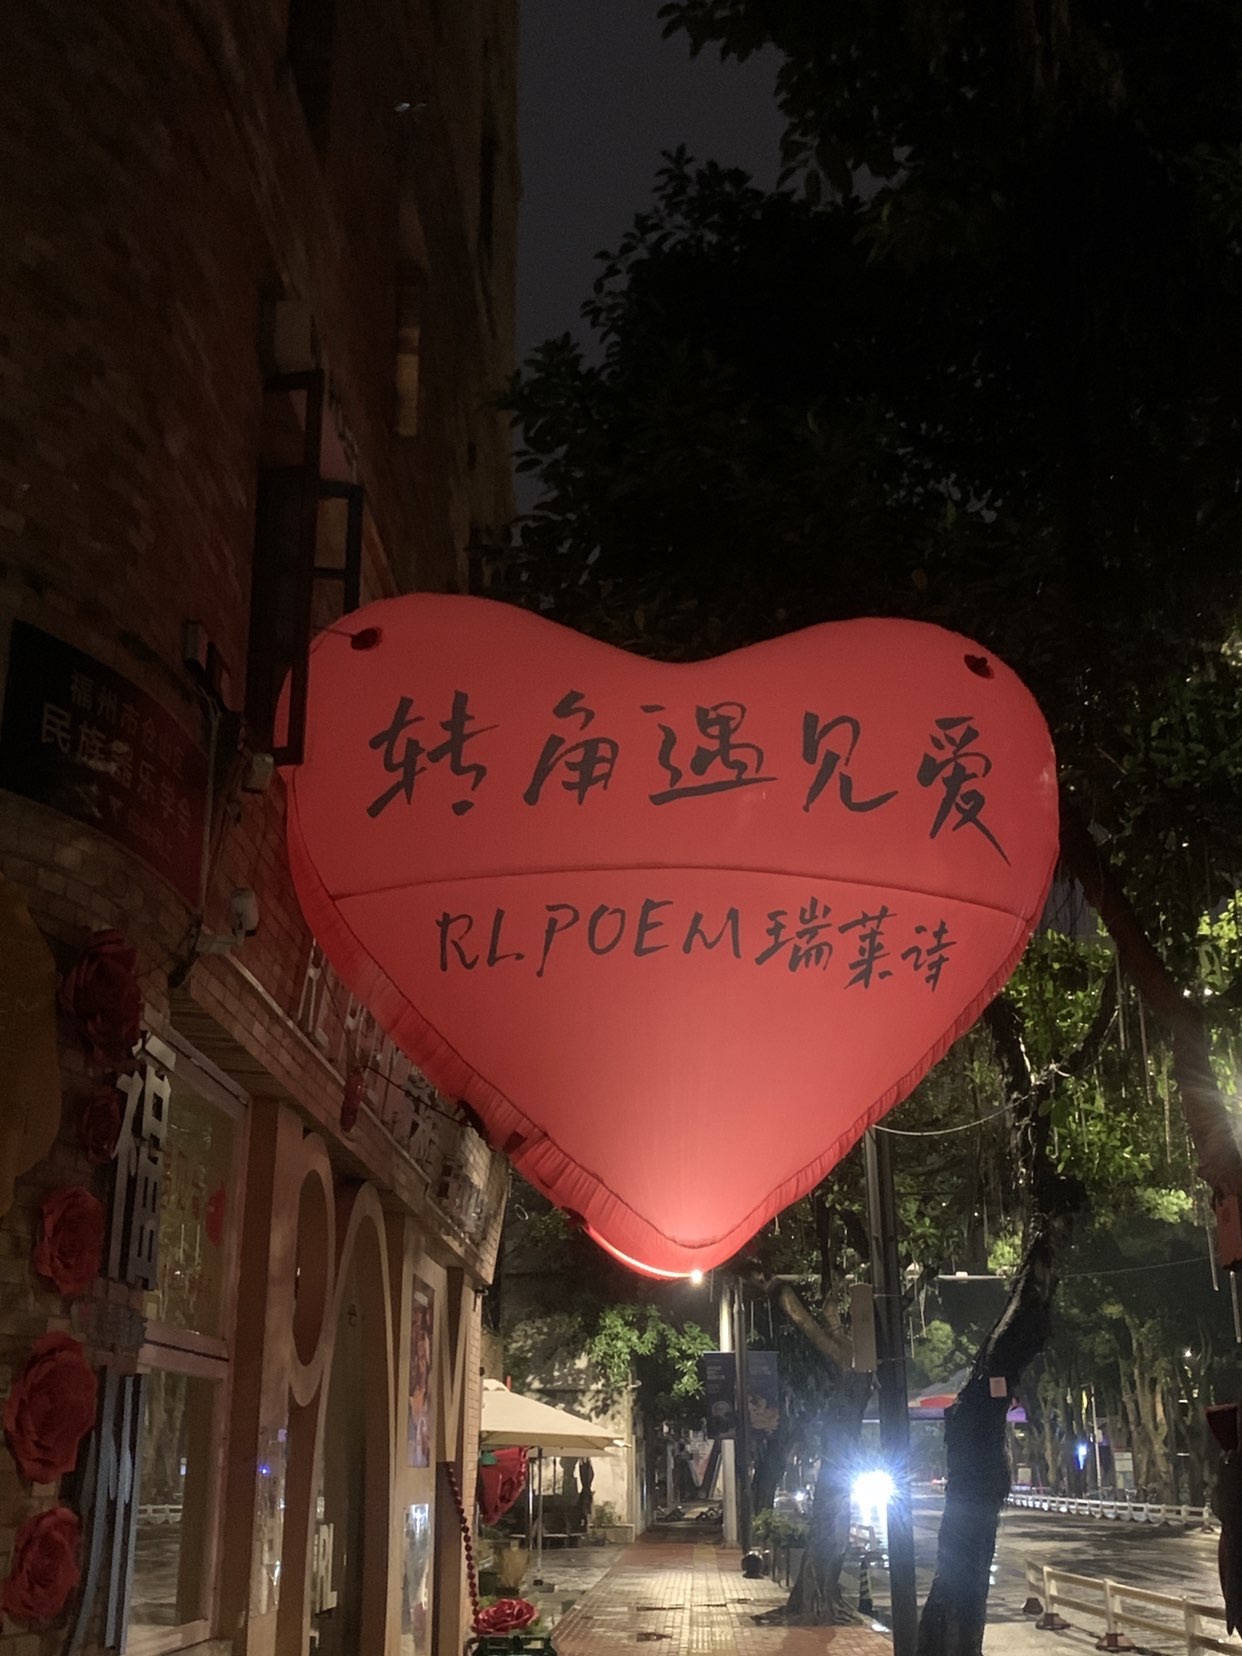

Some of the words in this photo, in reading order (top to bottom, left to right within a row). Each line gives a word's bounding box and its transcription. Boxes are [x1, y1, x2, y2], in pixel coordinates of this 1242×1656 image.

[366, 689, 1011, 867] 转角遇见爱
[755, 896, 957, 992] 瑞莱诗
